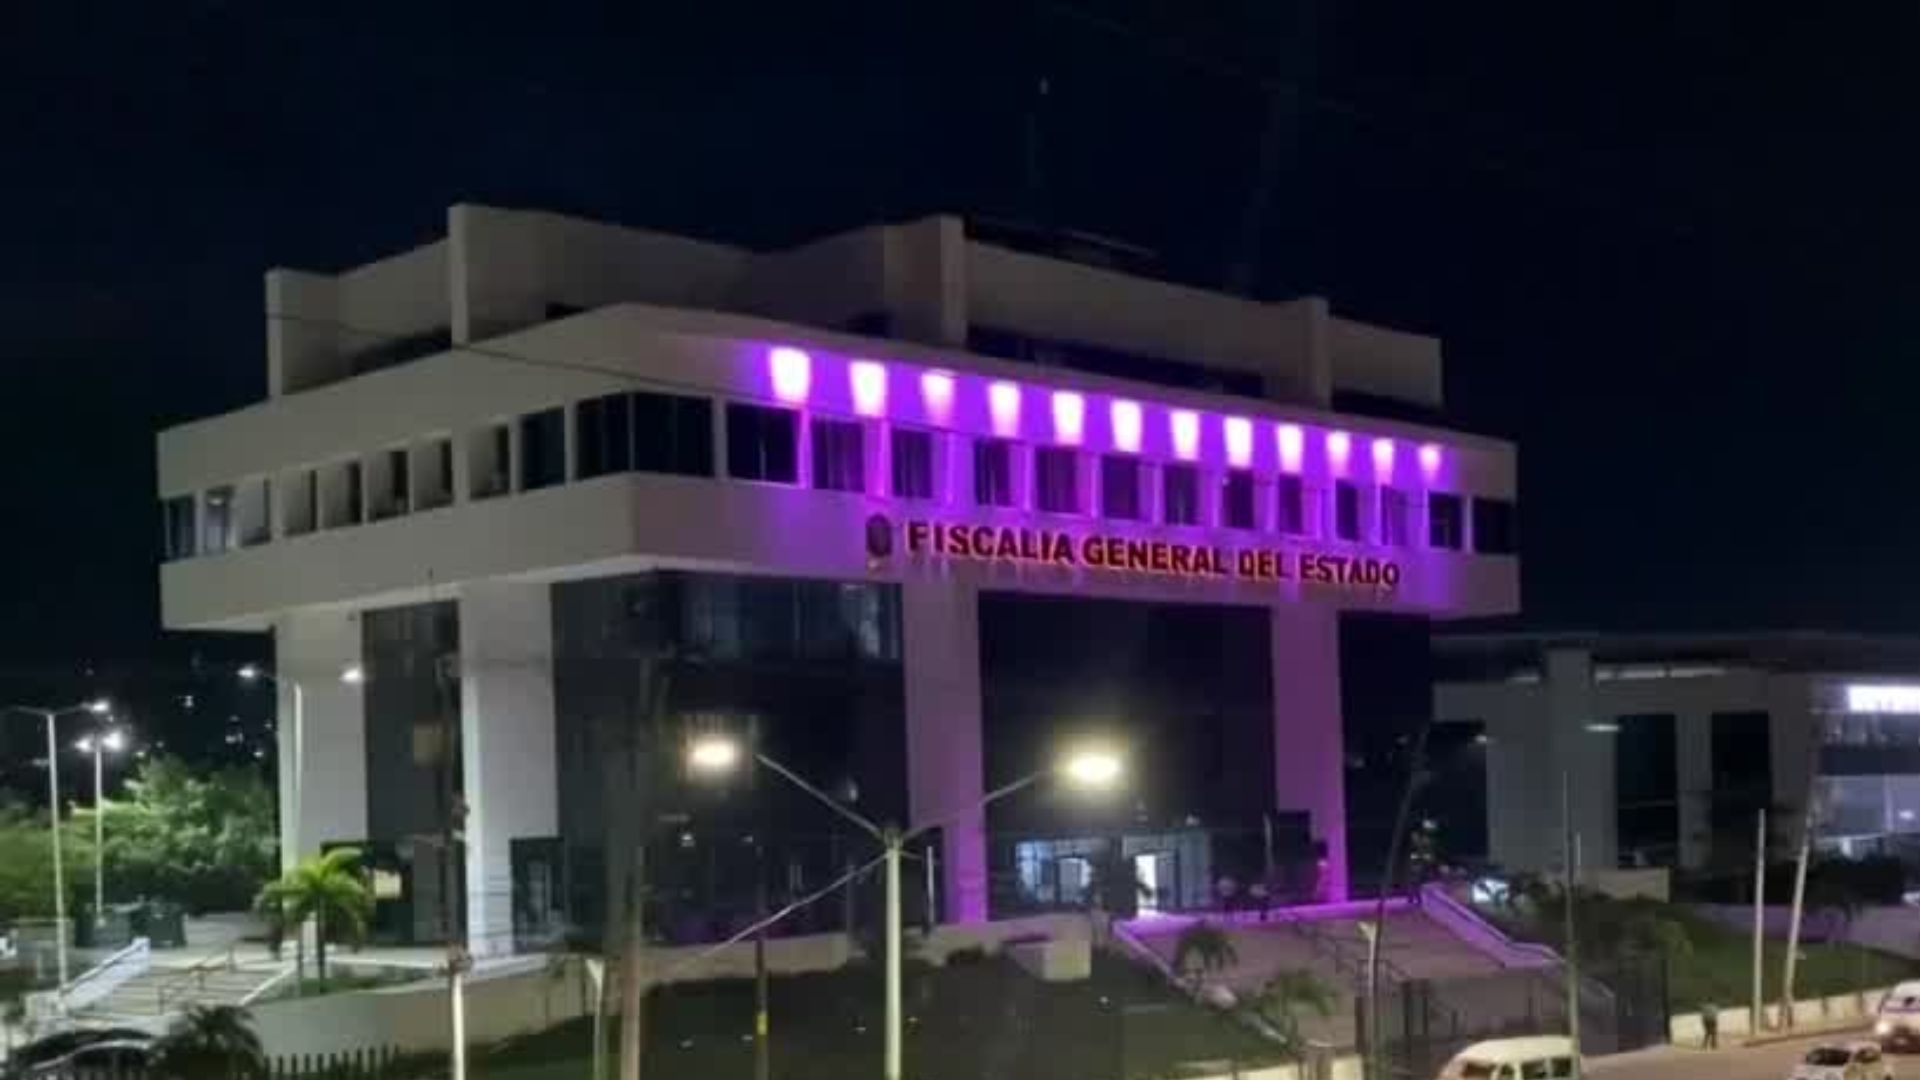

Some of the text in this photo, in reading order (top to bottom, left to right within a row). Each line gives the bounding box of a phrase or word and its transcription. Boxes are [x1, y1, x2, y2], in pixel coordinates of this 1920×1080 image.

[908, 521, 1400, 587] FISCALIA GENERAL DEL ESTADO
